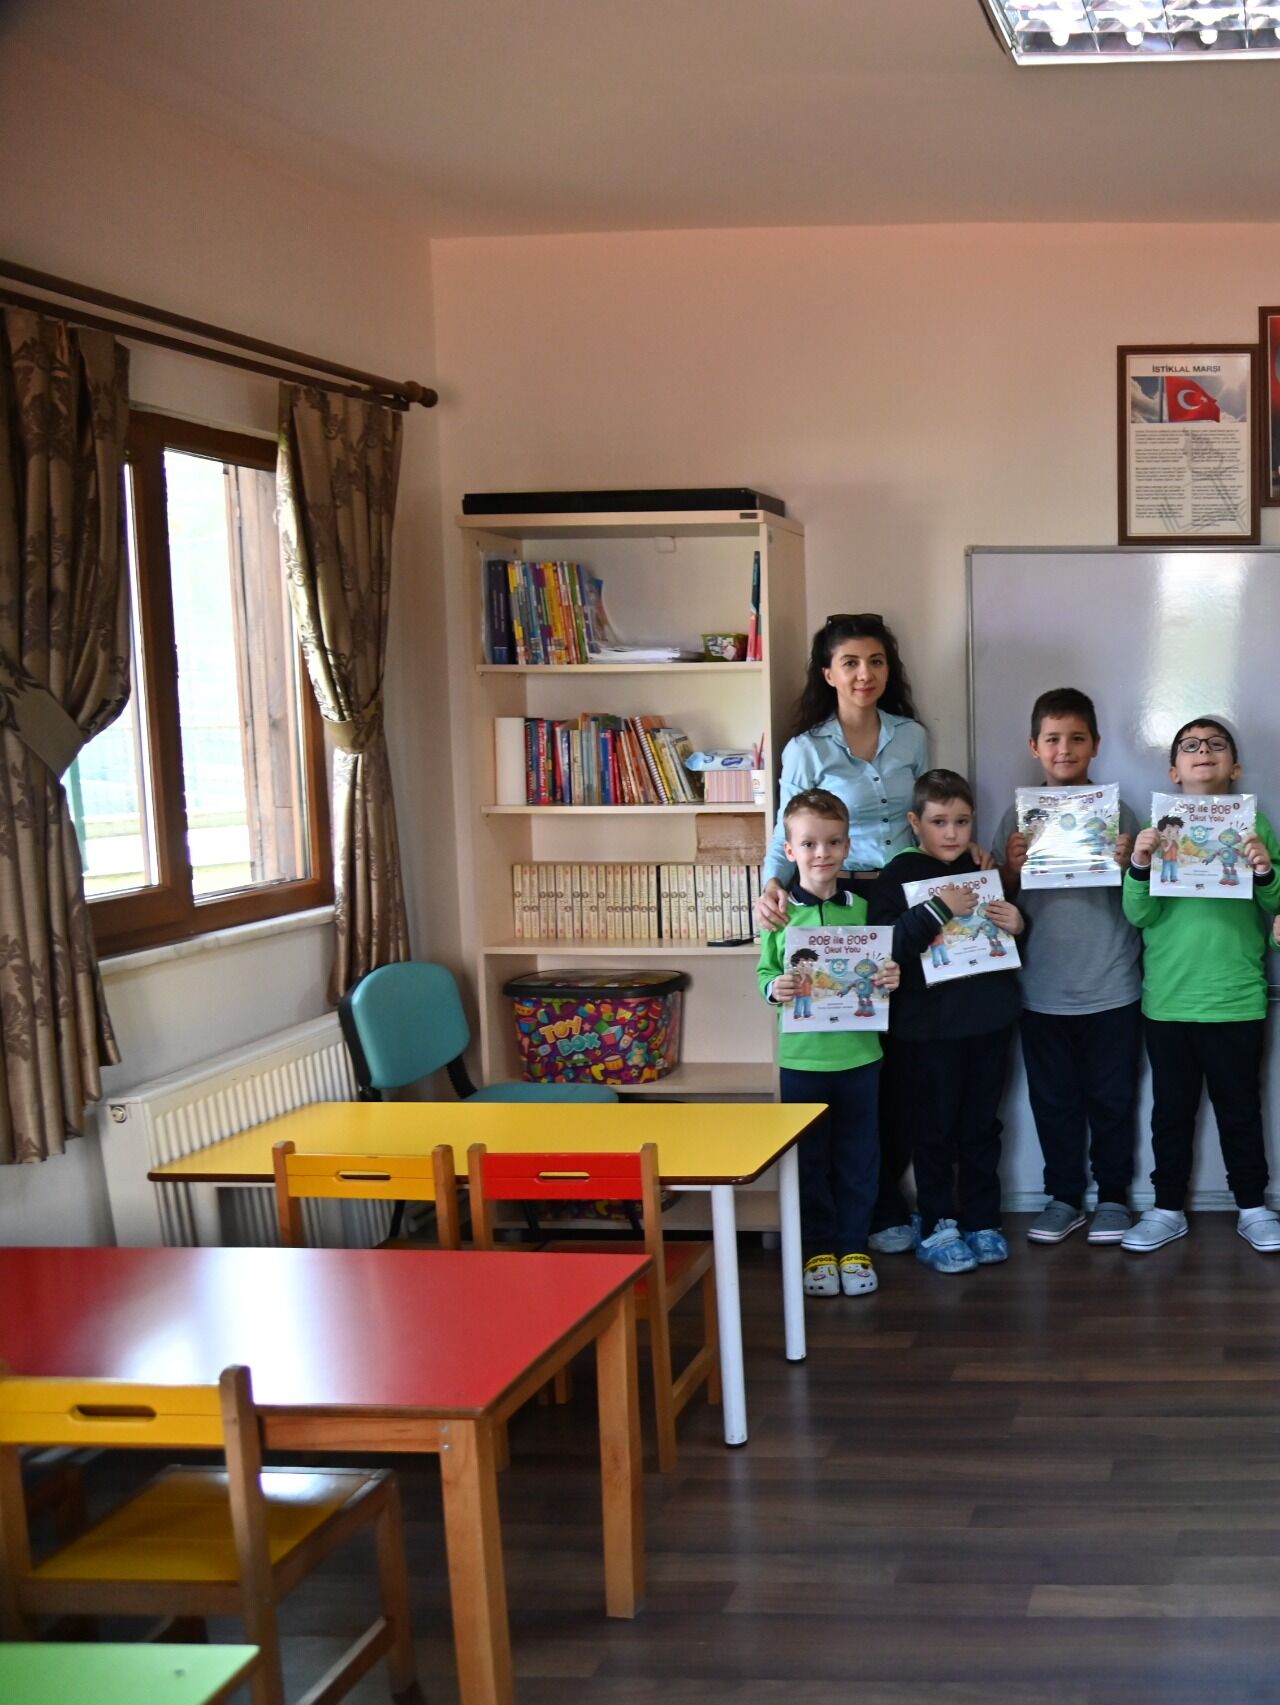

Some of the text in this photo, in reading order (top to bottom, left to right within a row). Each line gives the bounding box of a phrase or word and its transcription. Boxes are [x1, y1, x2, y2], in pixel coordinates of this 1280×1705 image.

[1152, 364, 1221, 373] İSTİKLAL MARŞI
[1211, 804, 1231, 814] BOB
[808, 935, 831, 945] ROB
[833, 936, 844, 944] ile
[847, 935, 868, 945] BOB
[539, 1015, 582, 1044] TOY
[556, 1032, 601, 1056] BOX
